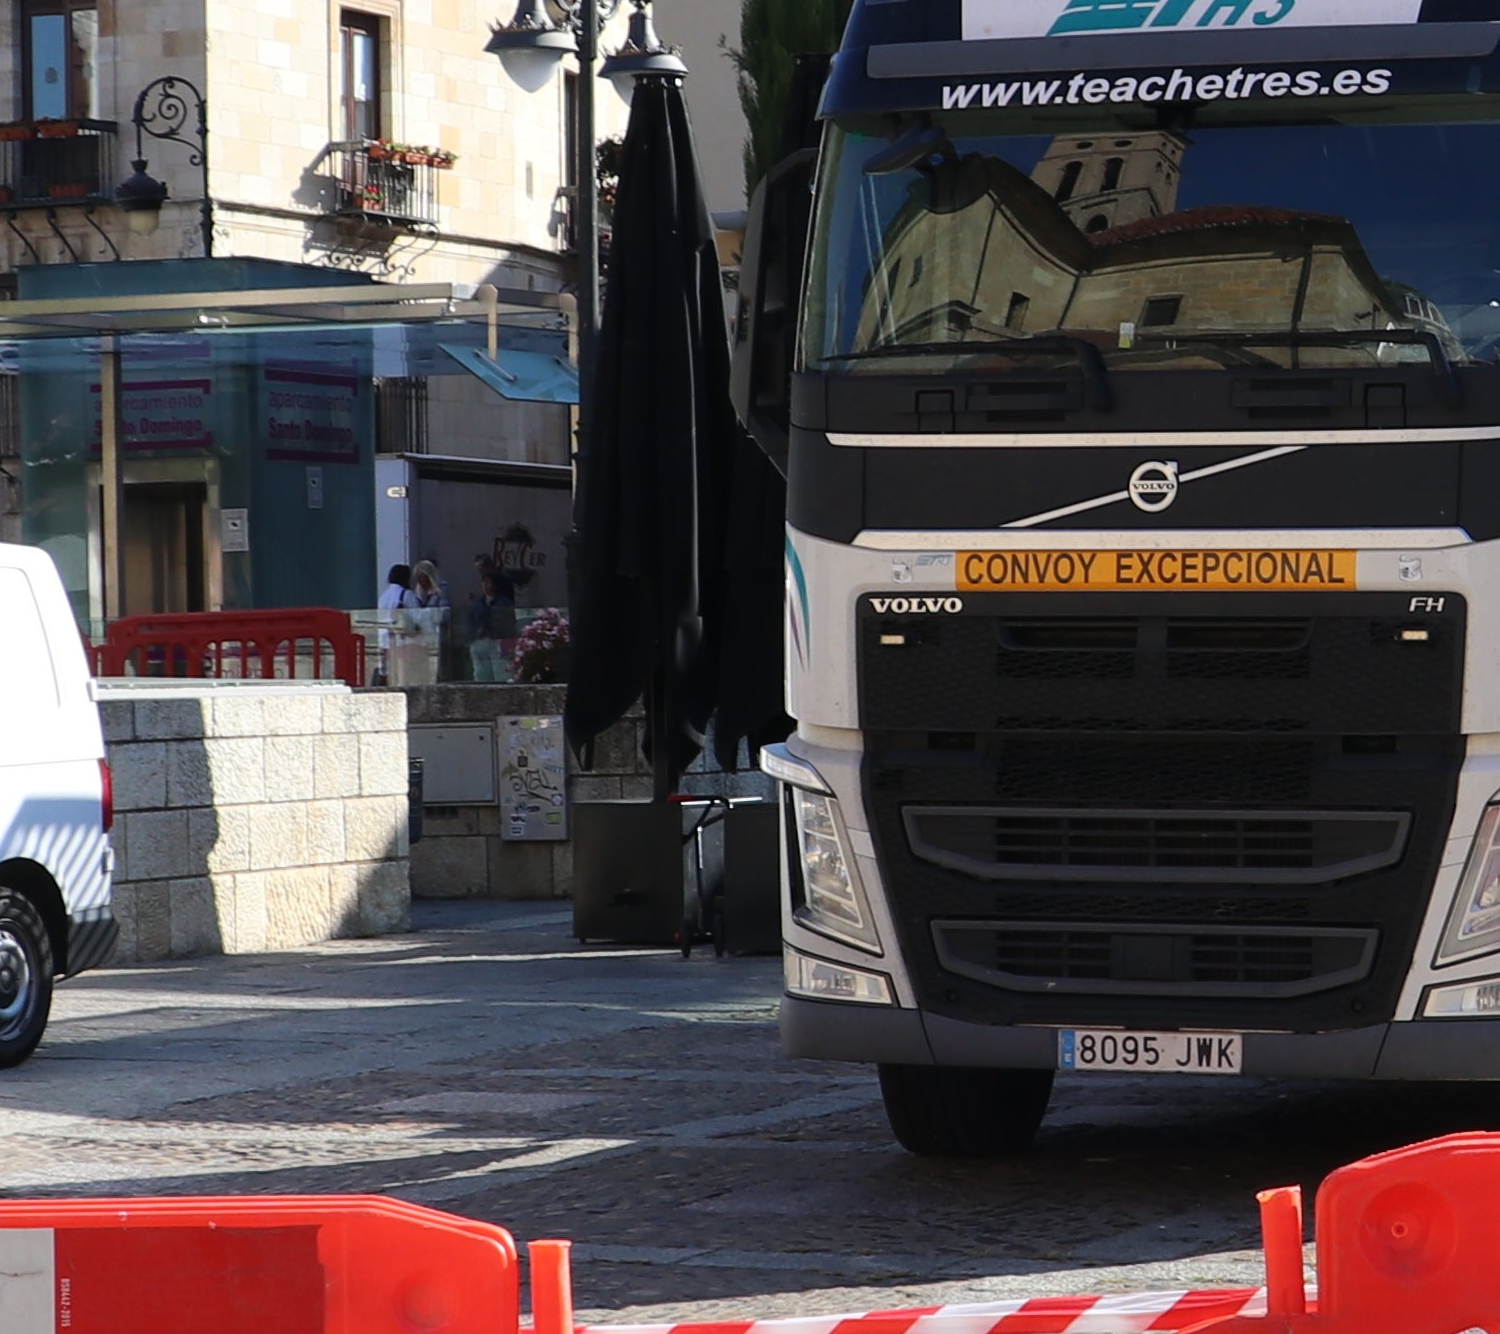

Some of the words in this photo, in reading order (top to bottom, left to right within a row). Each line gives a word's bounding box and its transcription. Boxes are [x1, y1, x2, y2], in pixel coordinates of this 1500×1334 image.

[941, 67, 1393, 110] www.teachetres.es
[1132, 482, 1175, 490] VOLVO
[964, 553, 1097, 584] CONVOY
[1115, 552, 1345, 584] EXCEPCIONAL
[869, 597, 963, 613] VOLVO
[1409, 597, 1445, 612] FH
[1080, 1035, 1159, 1065] 8095
[1176, 1037, 1235, 1067] JWK
